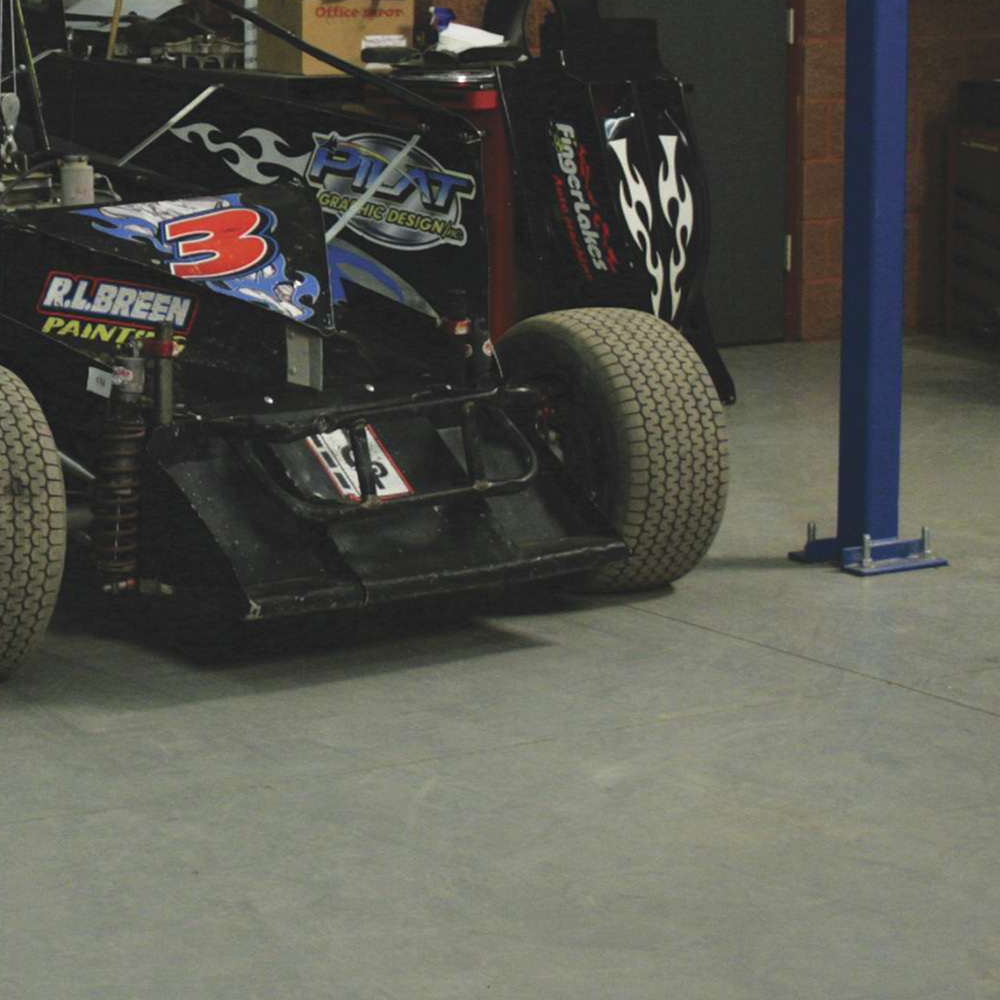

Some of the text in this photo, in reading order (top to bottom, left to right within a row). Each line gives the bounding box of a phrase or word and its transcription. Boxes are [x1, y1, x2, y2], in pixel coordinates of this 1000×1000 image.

[315, 6, 359, 18] Office
[387, 209, 446, 234] DESIGN
[160, 207, 268, 280] 3
